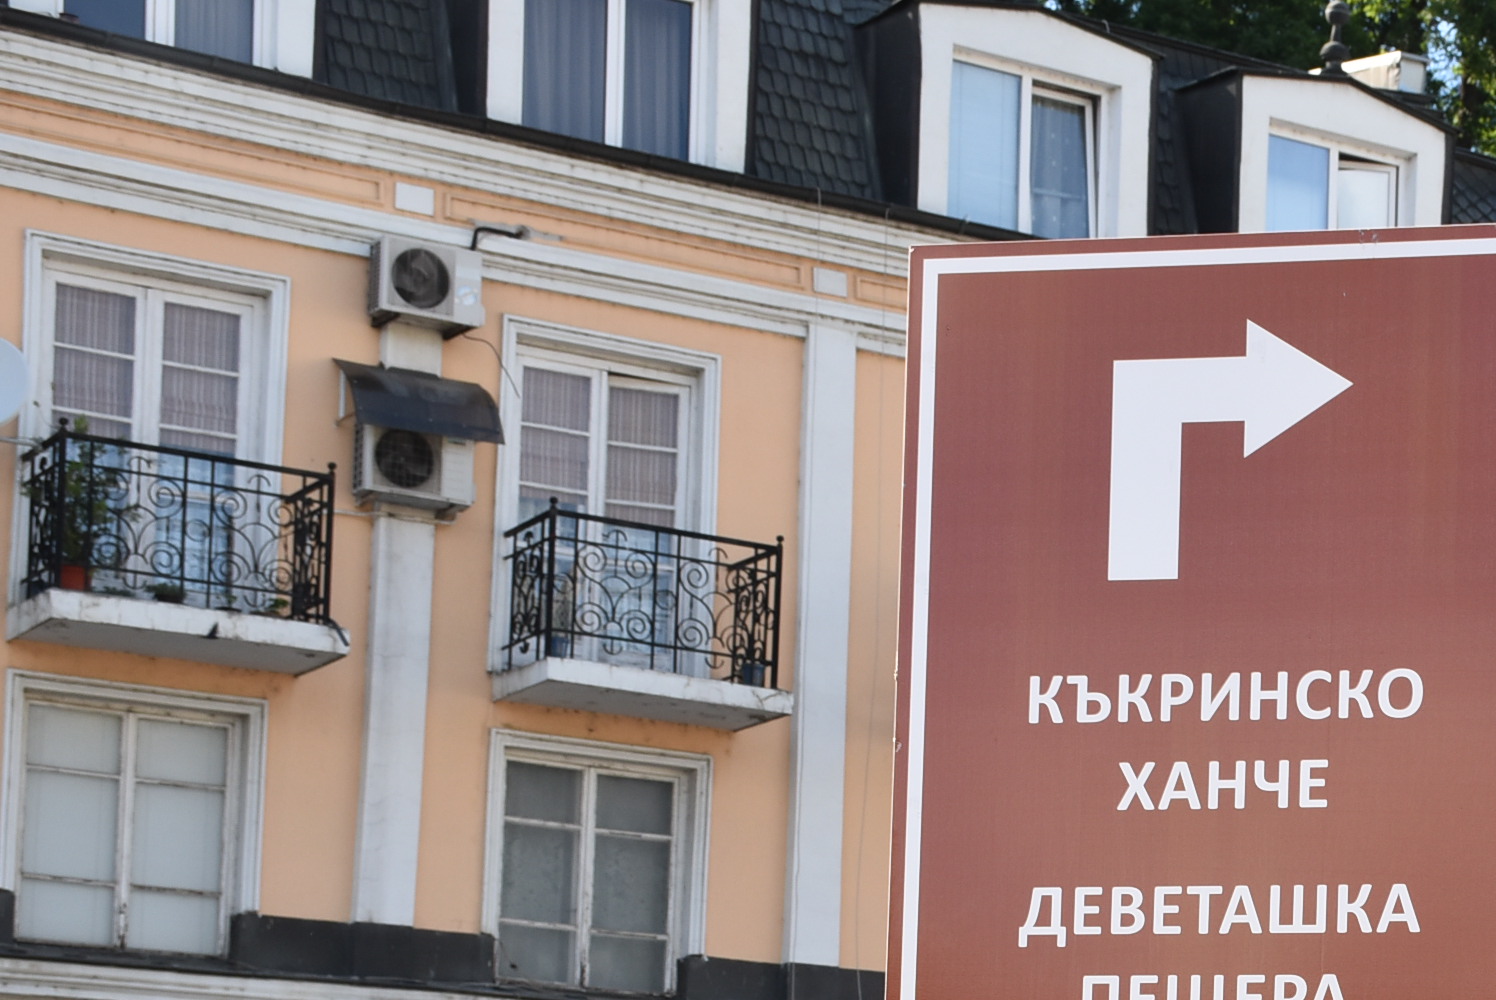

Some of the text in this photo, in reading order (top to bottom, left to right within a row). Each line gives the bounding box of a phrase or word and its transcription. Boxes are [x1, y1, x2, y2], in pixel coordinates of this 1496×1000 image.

[1028, 668, 1424, 724] КЪКРИНСКО
[1116, 759, 1329, 811] ХАНЧЕ
[1018, 884, 1421, 948] ДЕВЕТАШКА
